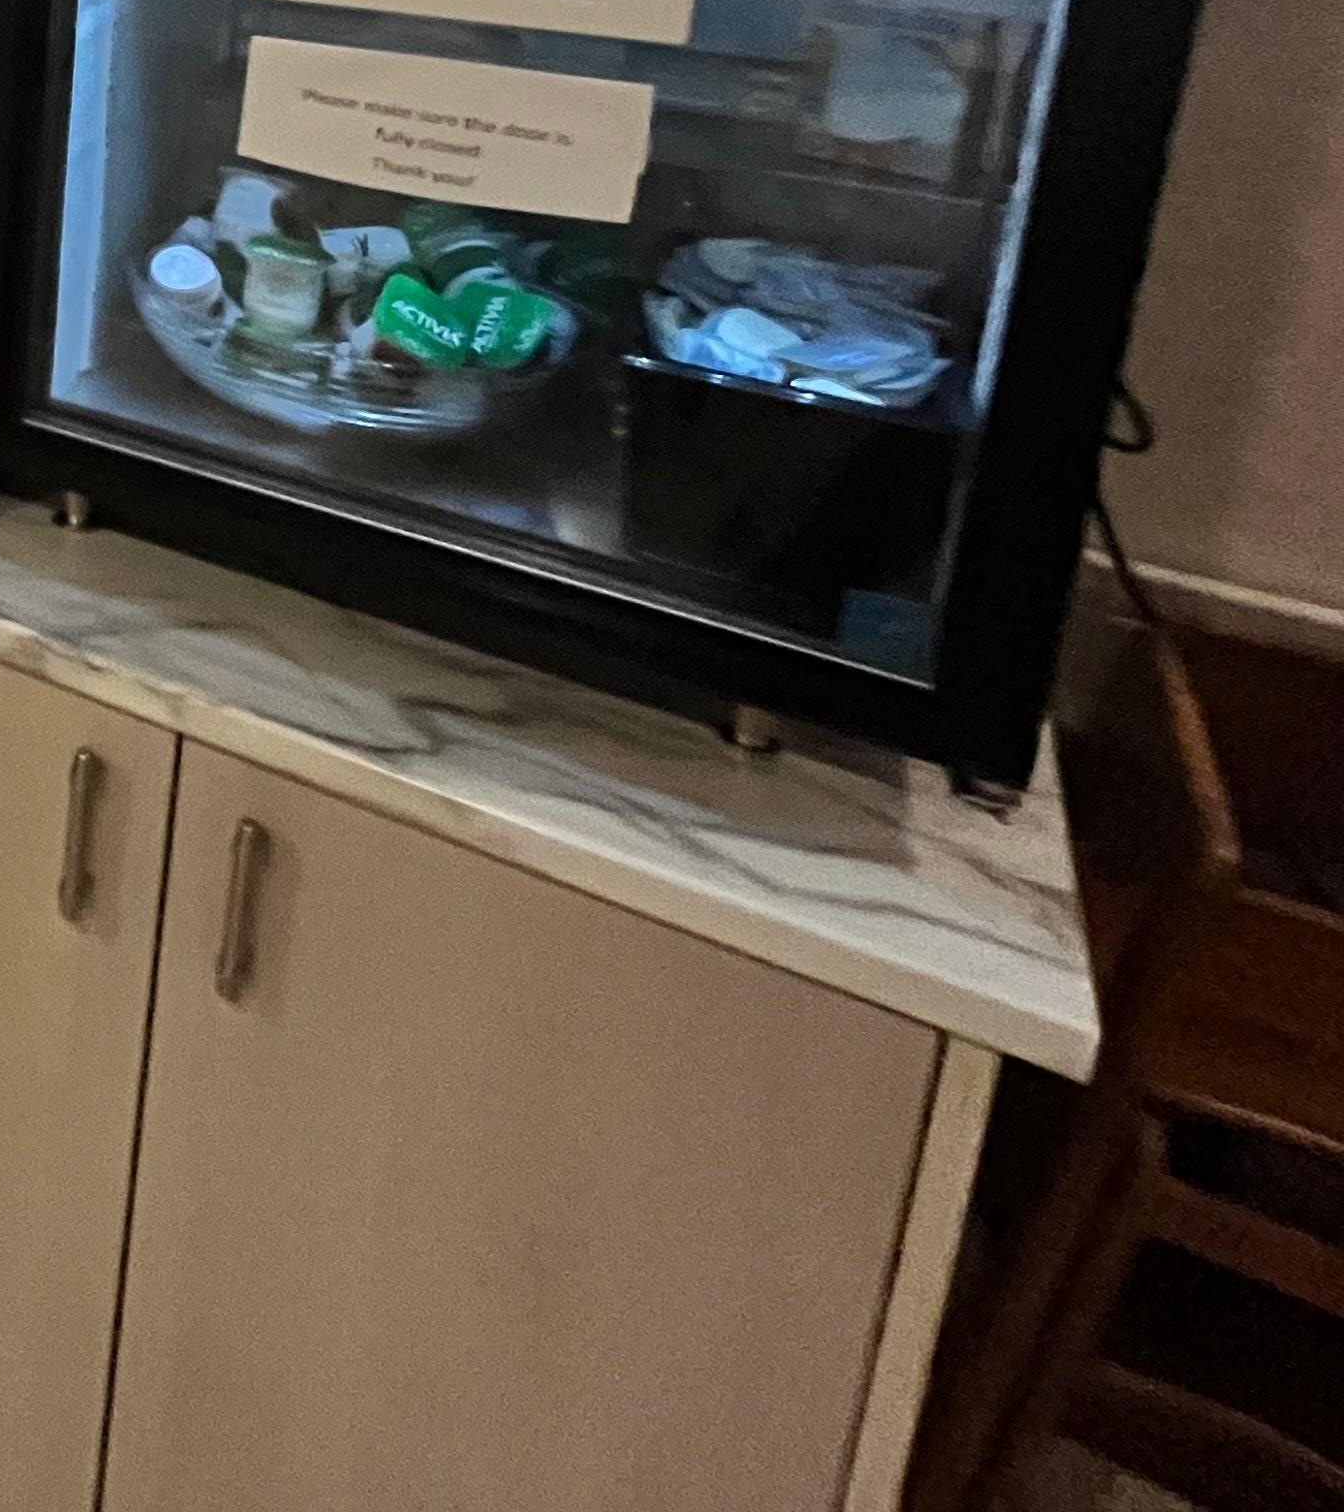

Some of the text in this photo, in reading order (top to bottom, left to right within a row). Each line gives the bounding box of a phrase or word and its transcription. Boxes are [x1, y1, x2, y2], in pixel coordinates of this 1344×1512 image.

[463, 116, 498, 134] the
[376, 126, 414, 149] fully
[373, 156, 427, 179] Thank
[392, 299, 462, 348] ACTIVIA
[470, 296, 508, 354] ACTIVIA
